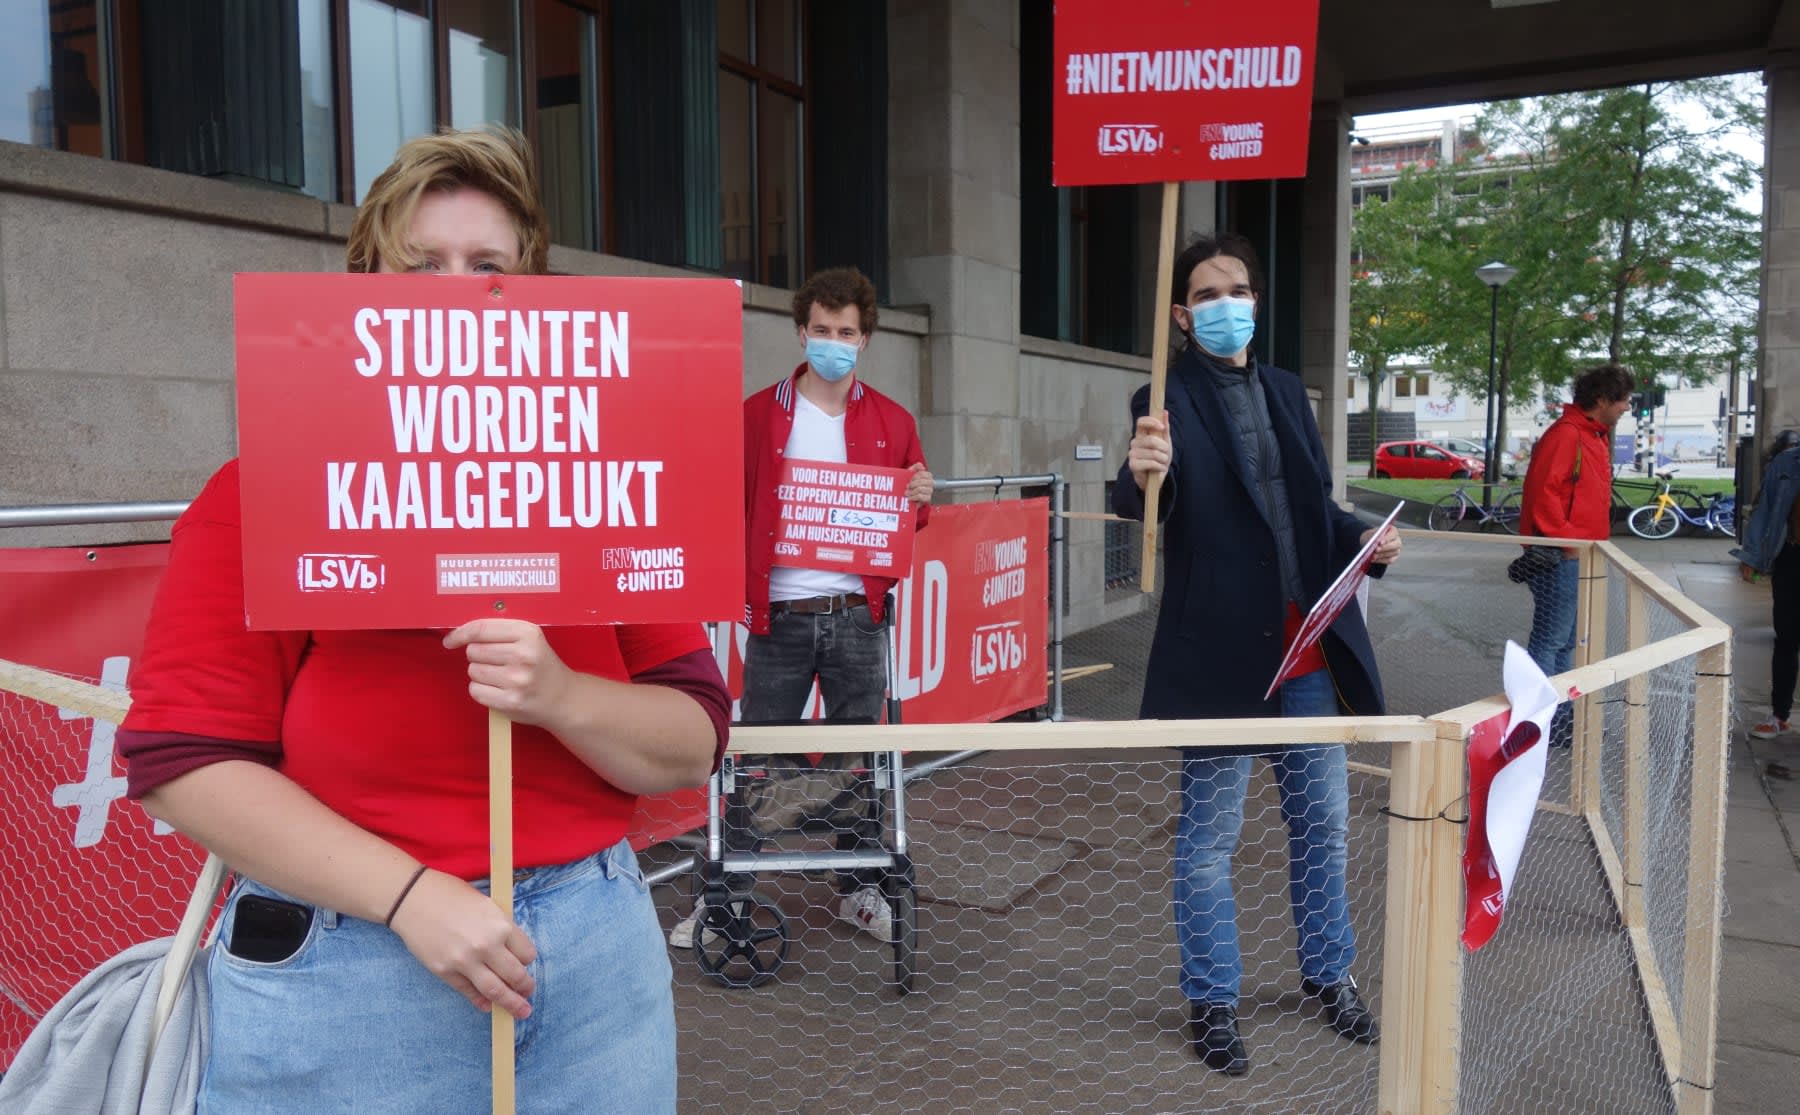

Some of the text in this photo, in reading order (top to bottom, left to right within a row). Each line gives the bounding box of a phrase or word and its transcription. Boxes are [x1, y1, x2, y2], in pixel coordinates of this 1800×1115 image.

[1066, 45, 1302, 95] #NIETMIJNSCHULD
[1101, 127, 1158, 154] LSVb
[353, 307, 630, 378] STUDENTEN
[387, 384, 600, 454] WORDEN
[791, 466, 894, 493] VOOR EEN KAMER VAN
[326, 460, 664, 530] KAALGEPLUKT
[777, 485, 910, 512] EZE OPPERVLAKTE BETAAL JE
[781, 504, 795, 520] AL
[795, 505, 826, 522] GAUW
[785, 524, 889, 548] AAN HUISJESMELKERS
[305, 558, 378, 589] LSVb
[440, 557, 556, 568] HUURPRIJZENACTIE
[440, 569, 557, 588] #NIETMIJNSCHULD
[616, 569, 684, 593] &UNITED
[974, 629, 1022, 678] LSVb
